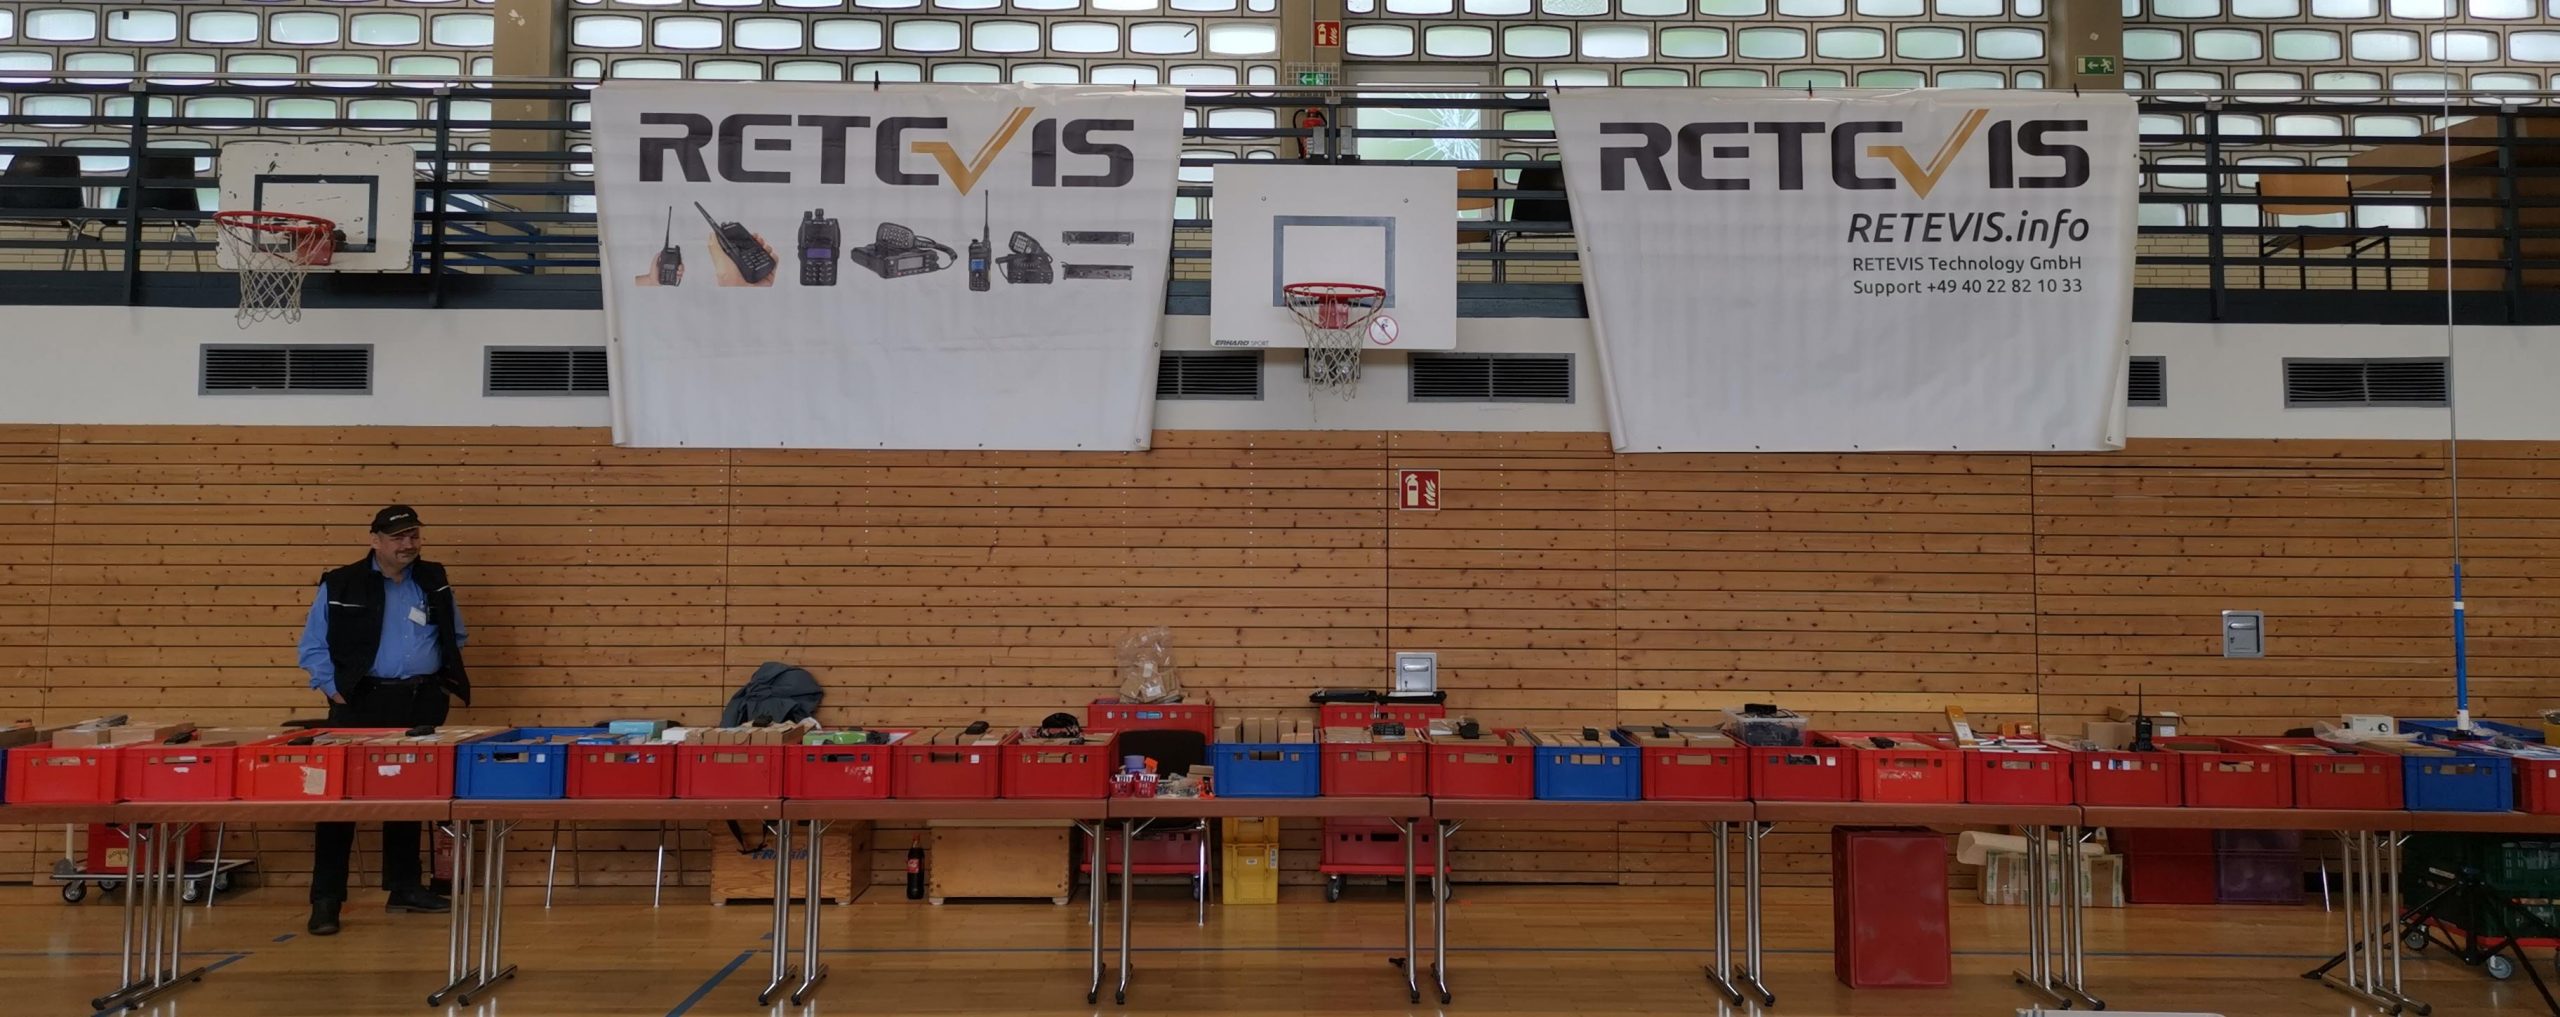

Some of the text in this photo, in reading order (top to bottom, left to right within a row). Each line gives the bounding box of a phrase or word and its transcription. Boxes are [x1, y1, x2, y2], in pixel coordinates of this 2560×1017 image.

[639, 106, 1134, 196] RETEVIS
[1599, 108, 2090, 200] RETEVIS
[1847, 208, 2090, 249] RETEVIS.info
[1853, 255, 2082, 273] RETEVIS Technology GmbH
[1853, 279, 2083, 297] Support +49 40 22 82 10 33
